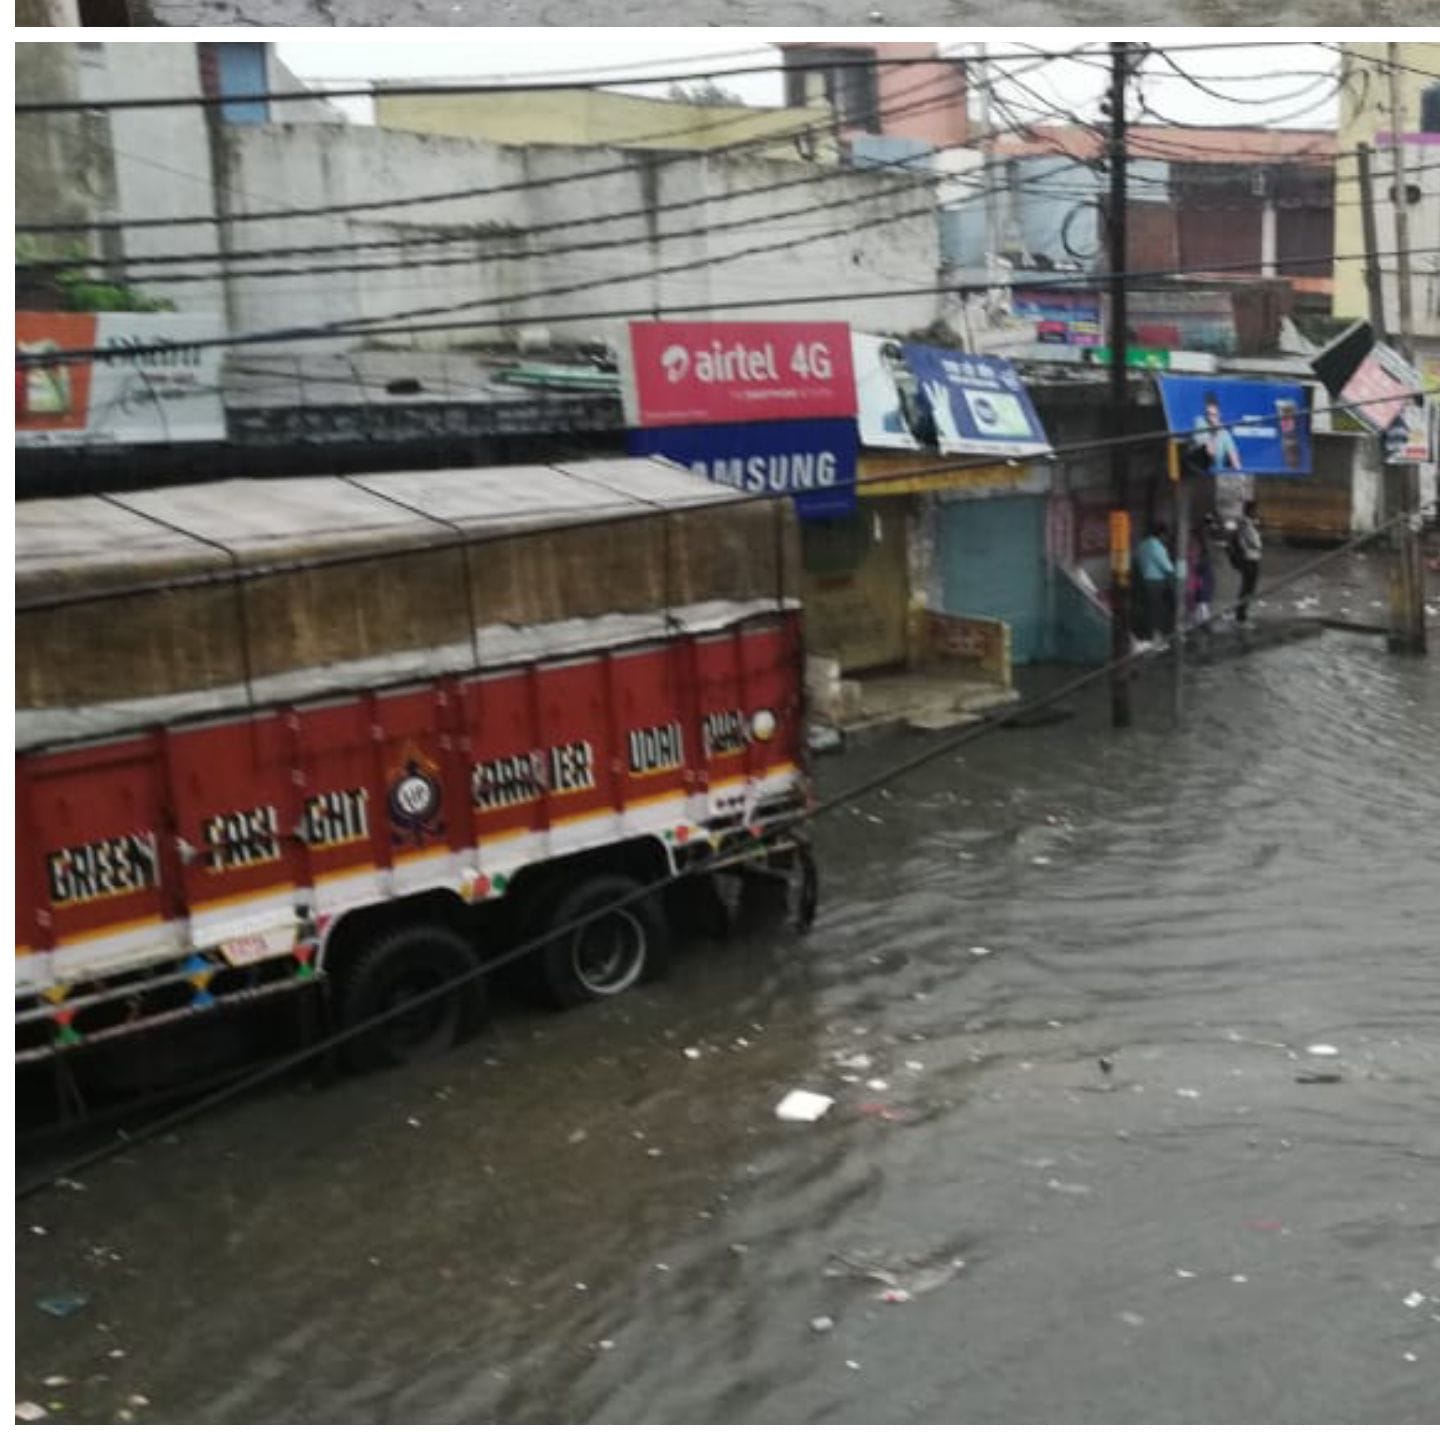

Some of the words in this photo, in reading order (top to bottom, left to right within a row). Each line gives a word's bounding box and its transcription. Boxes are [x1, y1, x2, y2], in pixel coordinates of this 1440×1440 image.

[695, 340, 780, 383] airtel
[789, 341, 834, 380] 4G
[688, 450, 838, 493] AMSUNG
[49, 828, 161, 902] GREEN
